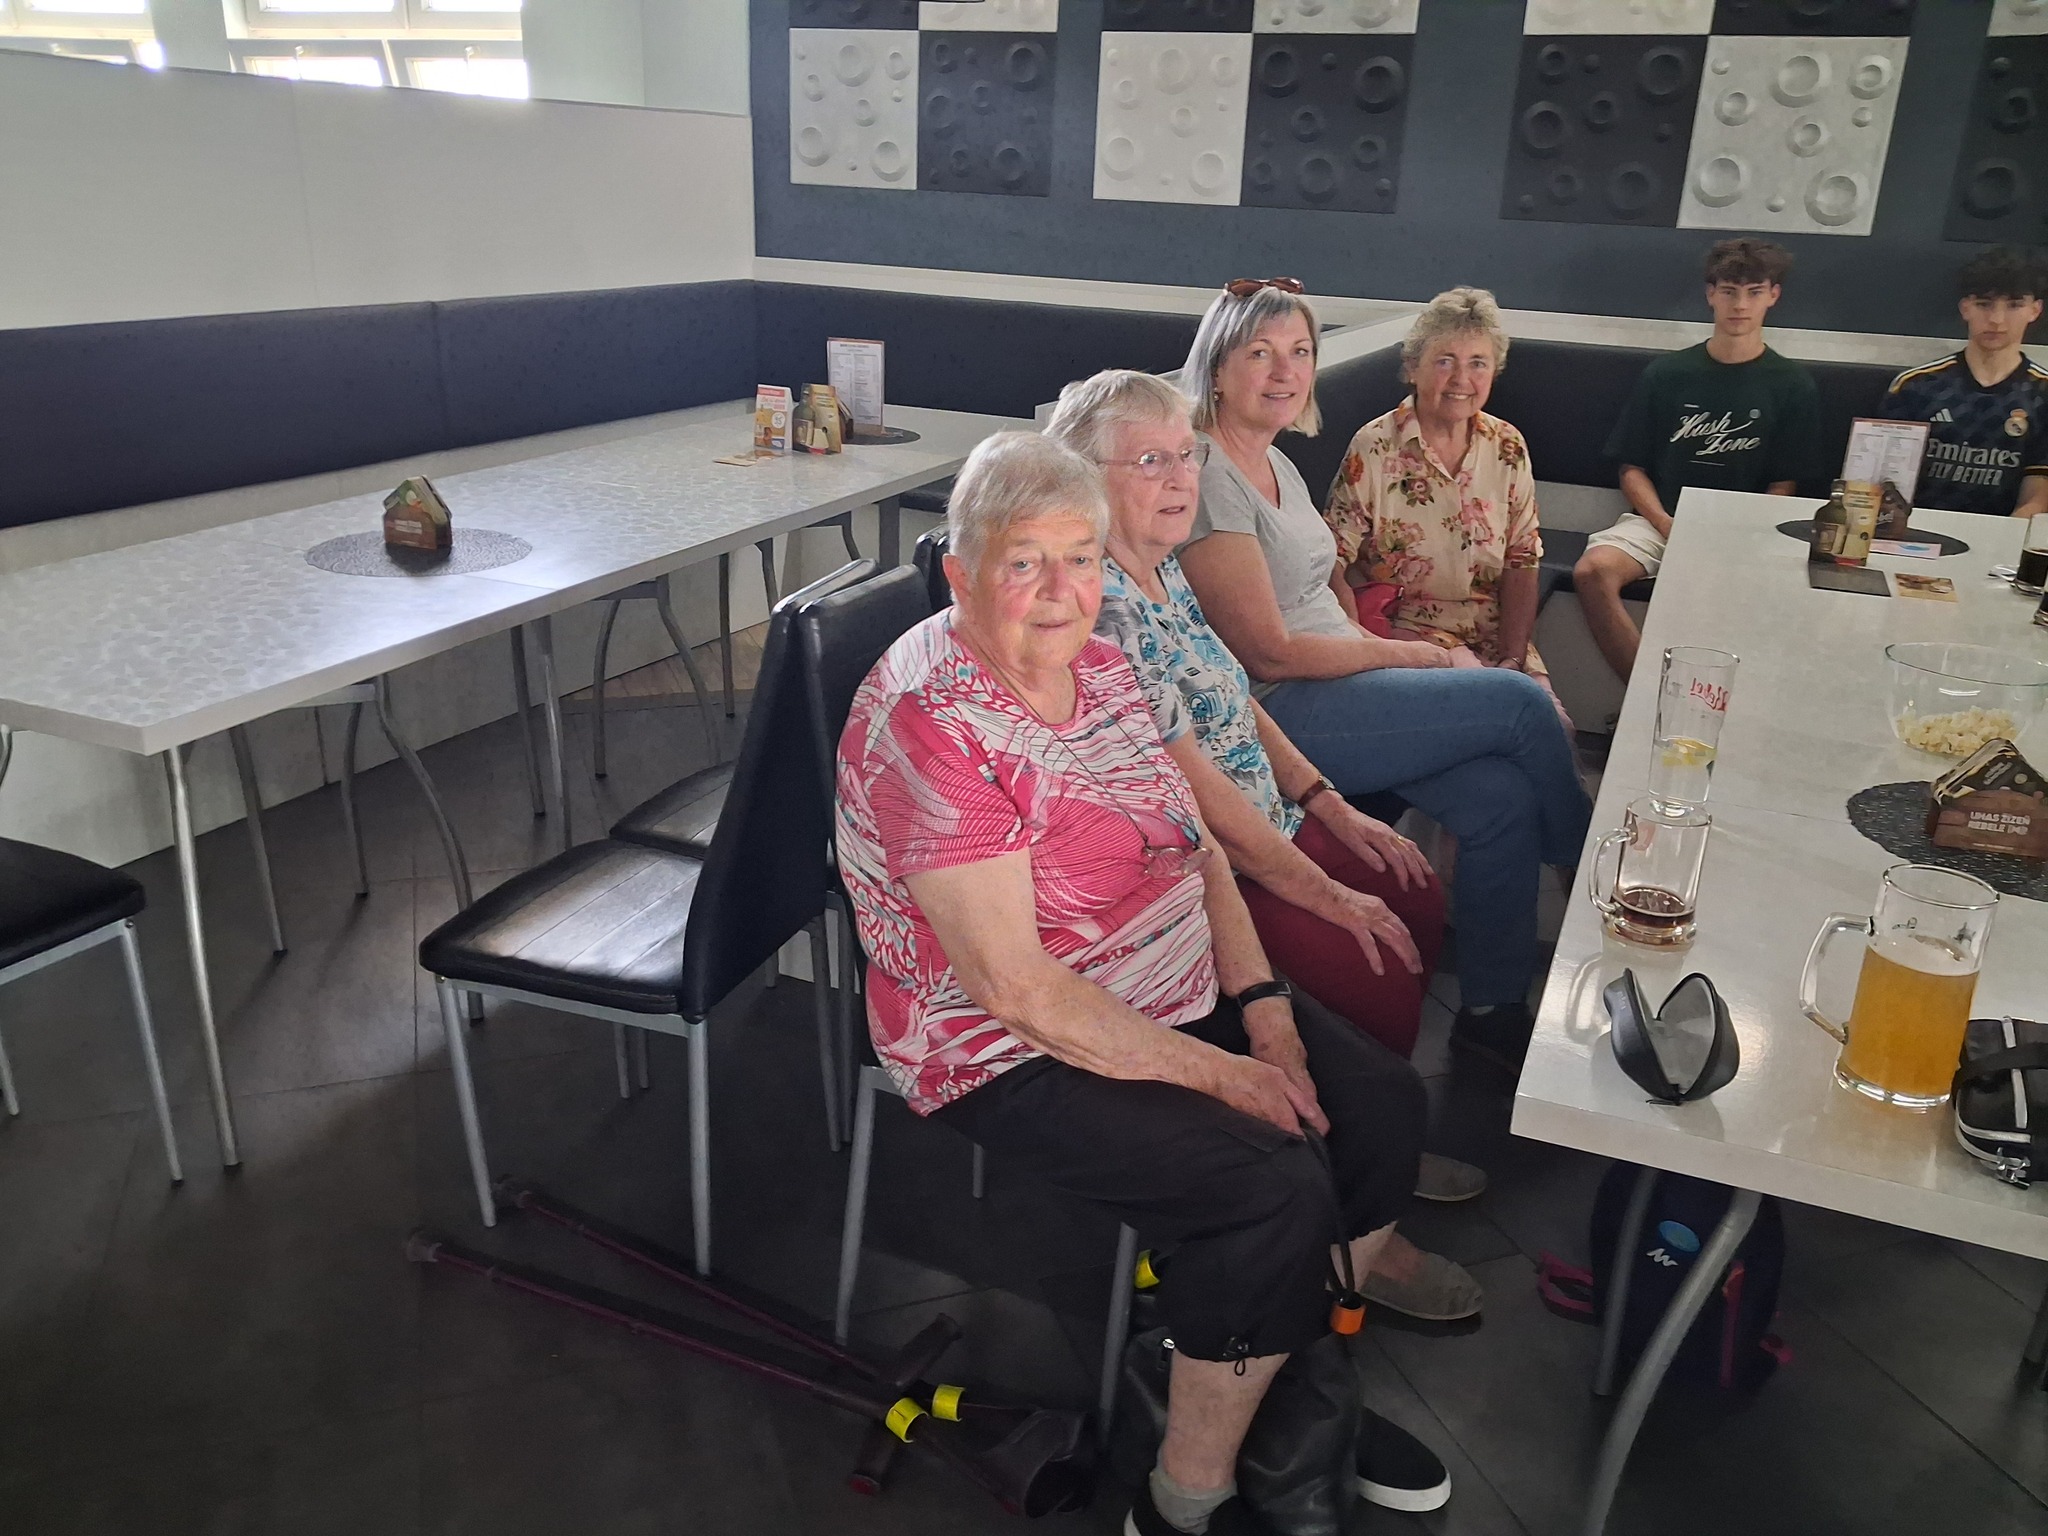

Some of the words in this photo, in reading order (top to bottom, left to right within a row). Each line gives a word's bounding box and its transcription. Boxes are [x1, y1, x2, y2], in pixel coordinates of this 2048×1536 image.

[1669, 410, 1738, 442] Hush
[1695, 433, 1761, 455] Zone
[1926, 437, 2021, 467] Emirates
[1928, 462, 1955, 478] FLY
[1952, 465, 2004, 485] BETTER
